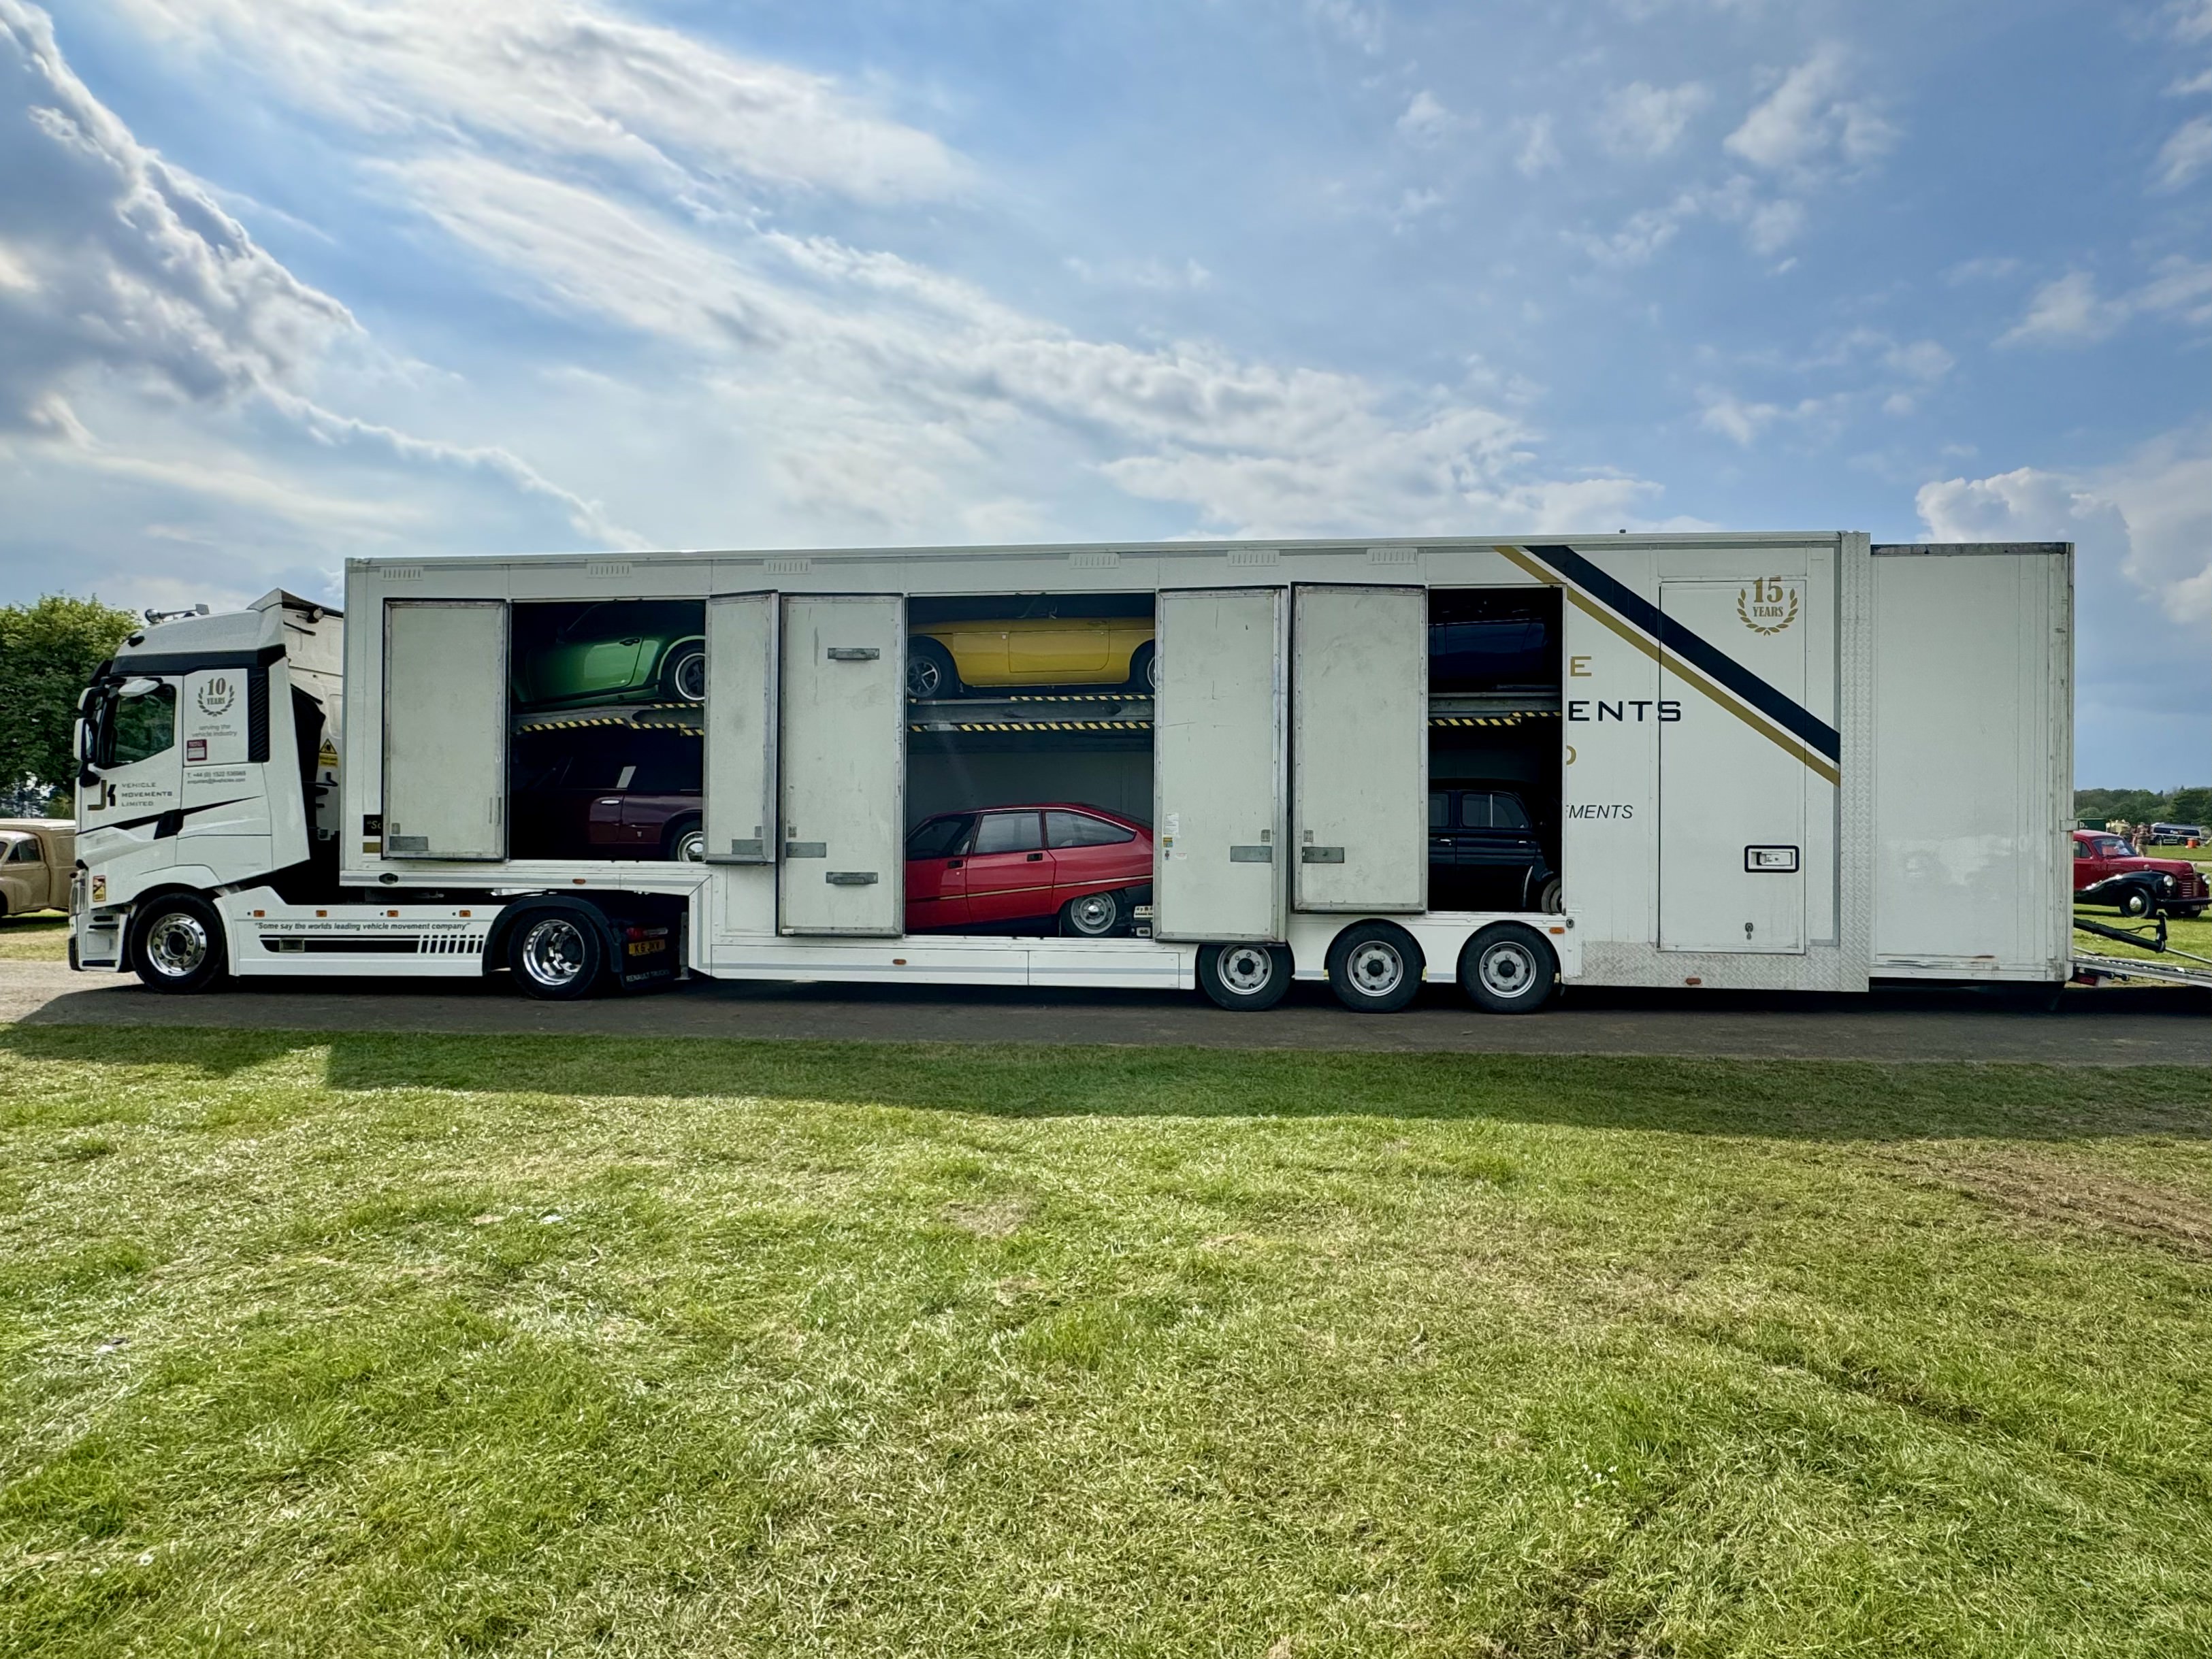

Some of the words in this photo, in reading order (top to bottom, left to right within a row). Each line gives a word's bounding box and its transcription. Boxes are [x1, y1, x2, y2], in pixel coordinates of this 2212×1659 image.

[1753, 576, 1783, 603] 15
[1753, 606, 1783, 617] YEARS
[207, 677, 226, 695] 10
[207, 697, 225, 705] YEARS
[1566, 804, 1633, 819] MENTS
[334, 923, 361, 931] leading
[626, 972, 649, 982] RENAULT
